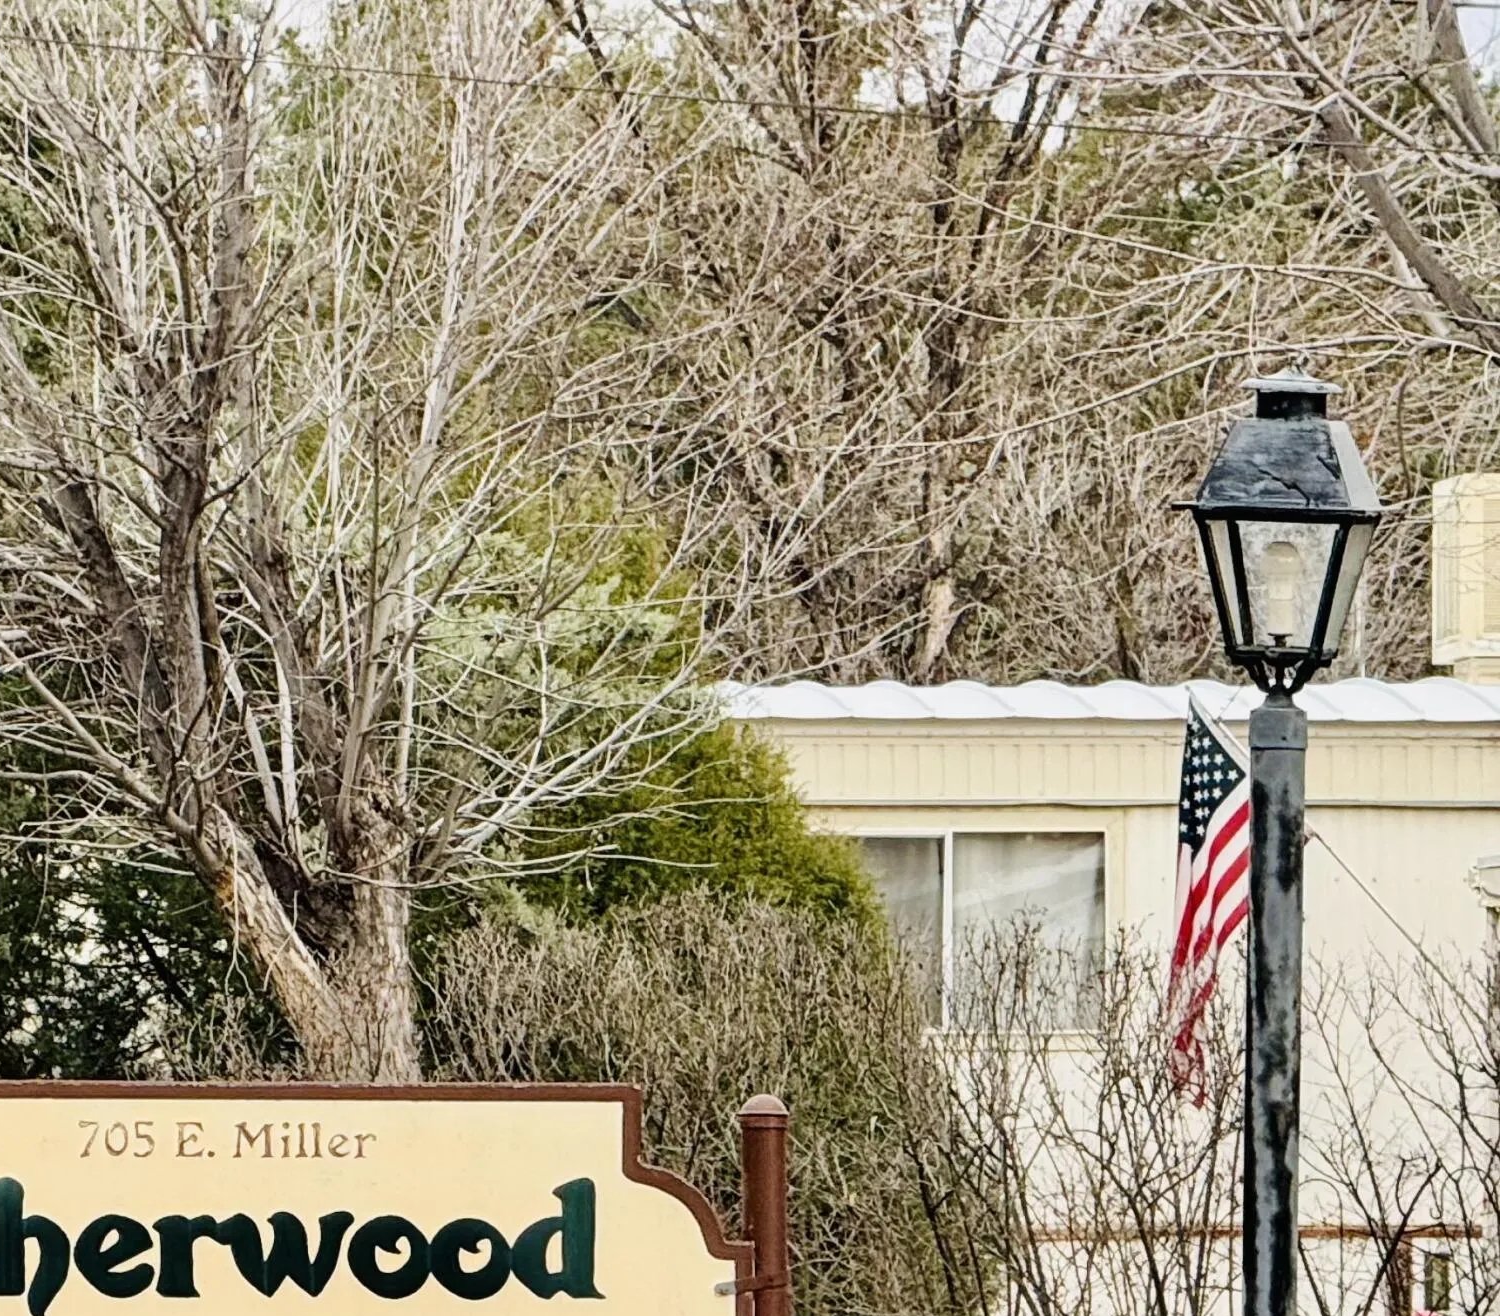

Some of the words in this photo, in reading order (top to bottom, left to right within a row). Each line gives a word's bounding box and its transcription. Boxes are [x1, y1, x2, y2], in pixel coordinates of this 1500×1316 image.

[78, 1120, 155, 1159] 705
[175, 1121, 216, 1158] E.
[232, 1121, 377, 1159] Miller
